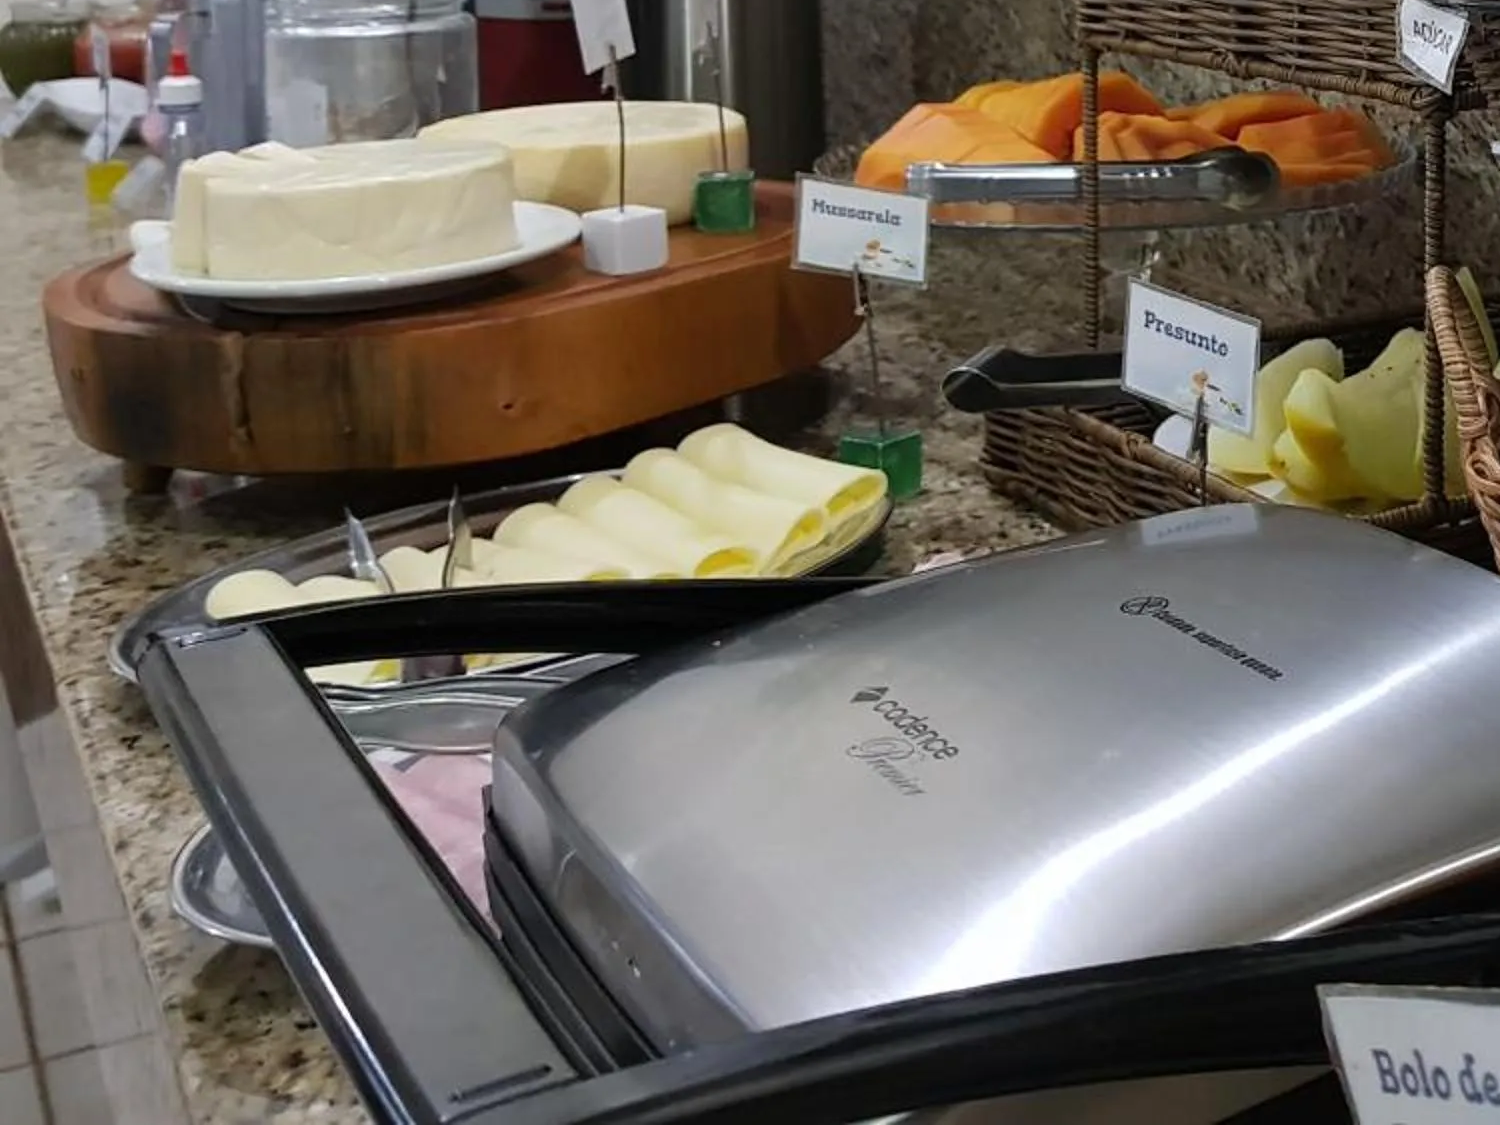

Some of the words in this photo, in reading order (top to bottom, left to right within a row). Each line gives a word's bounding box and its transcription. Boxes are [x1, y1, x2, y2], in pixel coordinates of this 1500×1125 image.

[811, 198, 902, 227] Mussarela
[1143, 308, 1229, 357] Presunto
[872, 700, 960, 760] cadence
[1371, 1048, 1452, 1100] Bolo
